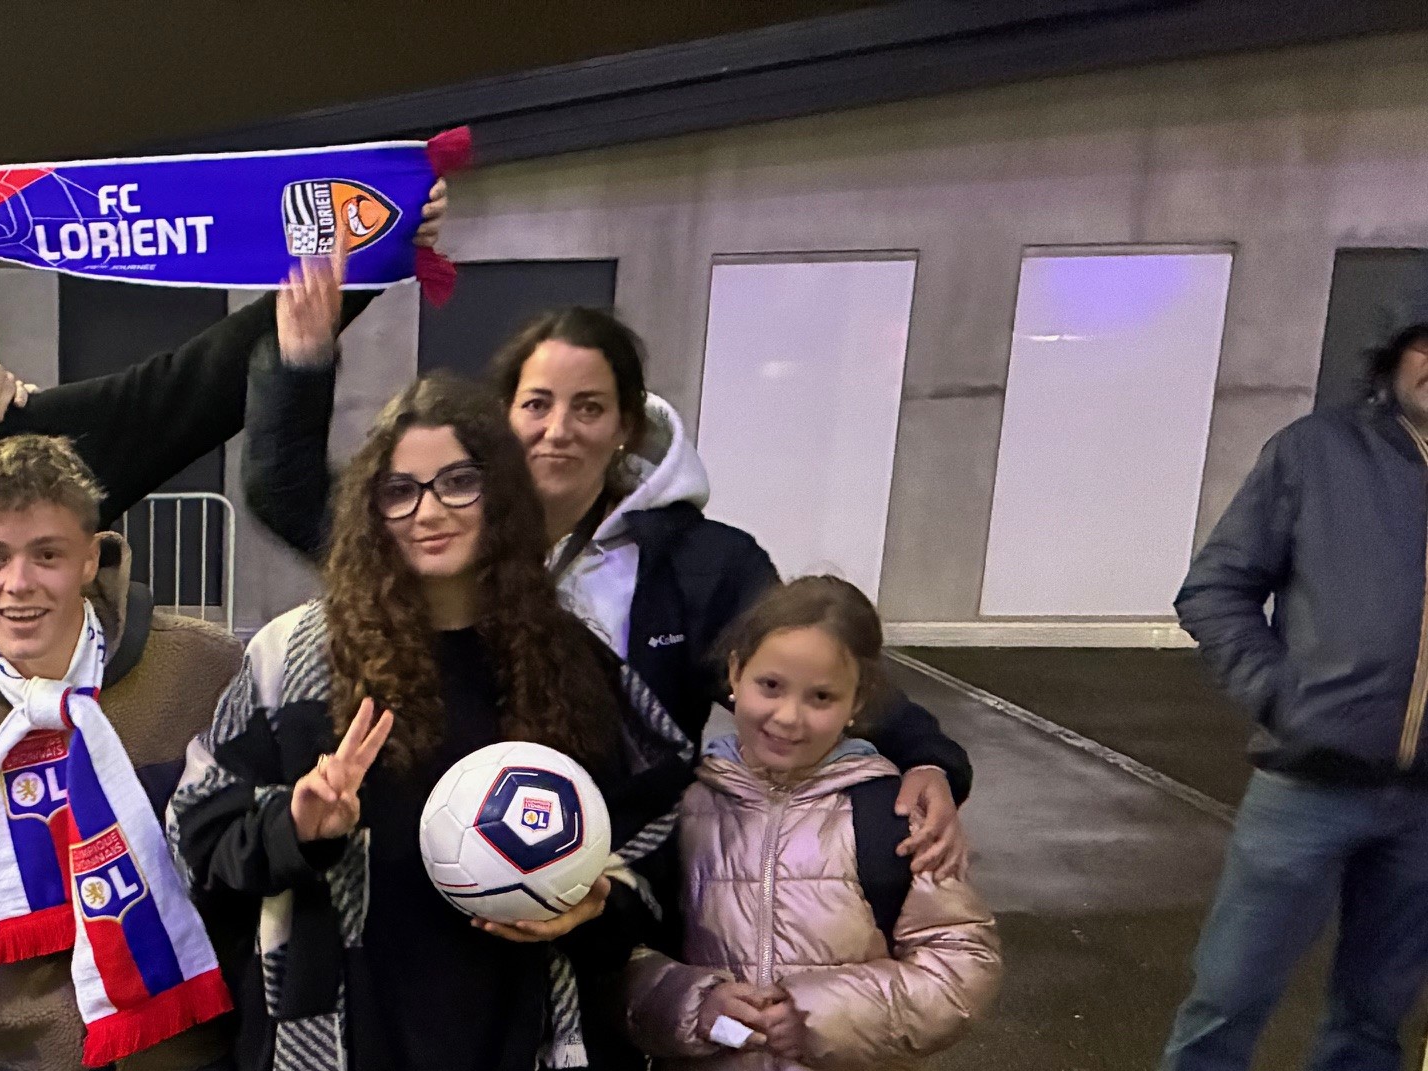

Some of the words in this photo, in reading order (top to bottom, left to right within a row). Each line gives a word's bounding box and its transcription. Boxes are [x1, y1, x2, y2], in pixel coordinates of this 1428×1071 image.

[98, 183, 141, 215] FC
[313, 182, 335, 235] LORIENT
[34, 216, 214, 261] LORIENT
[318, 237, 334, 253] FC
